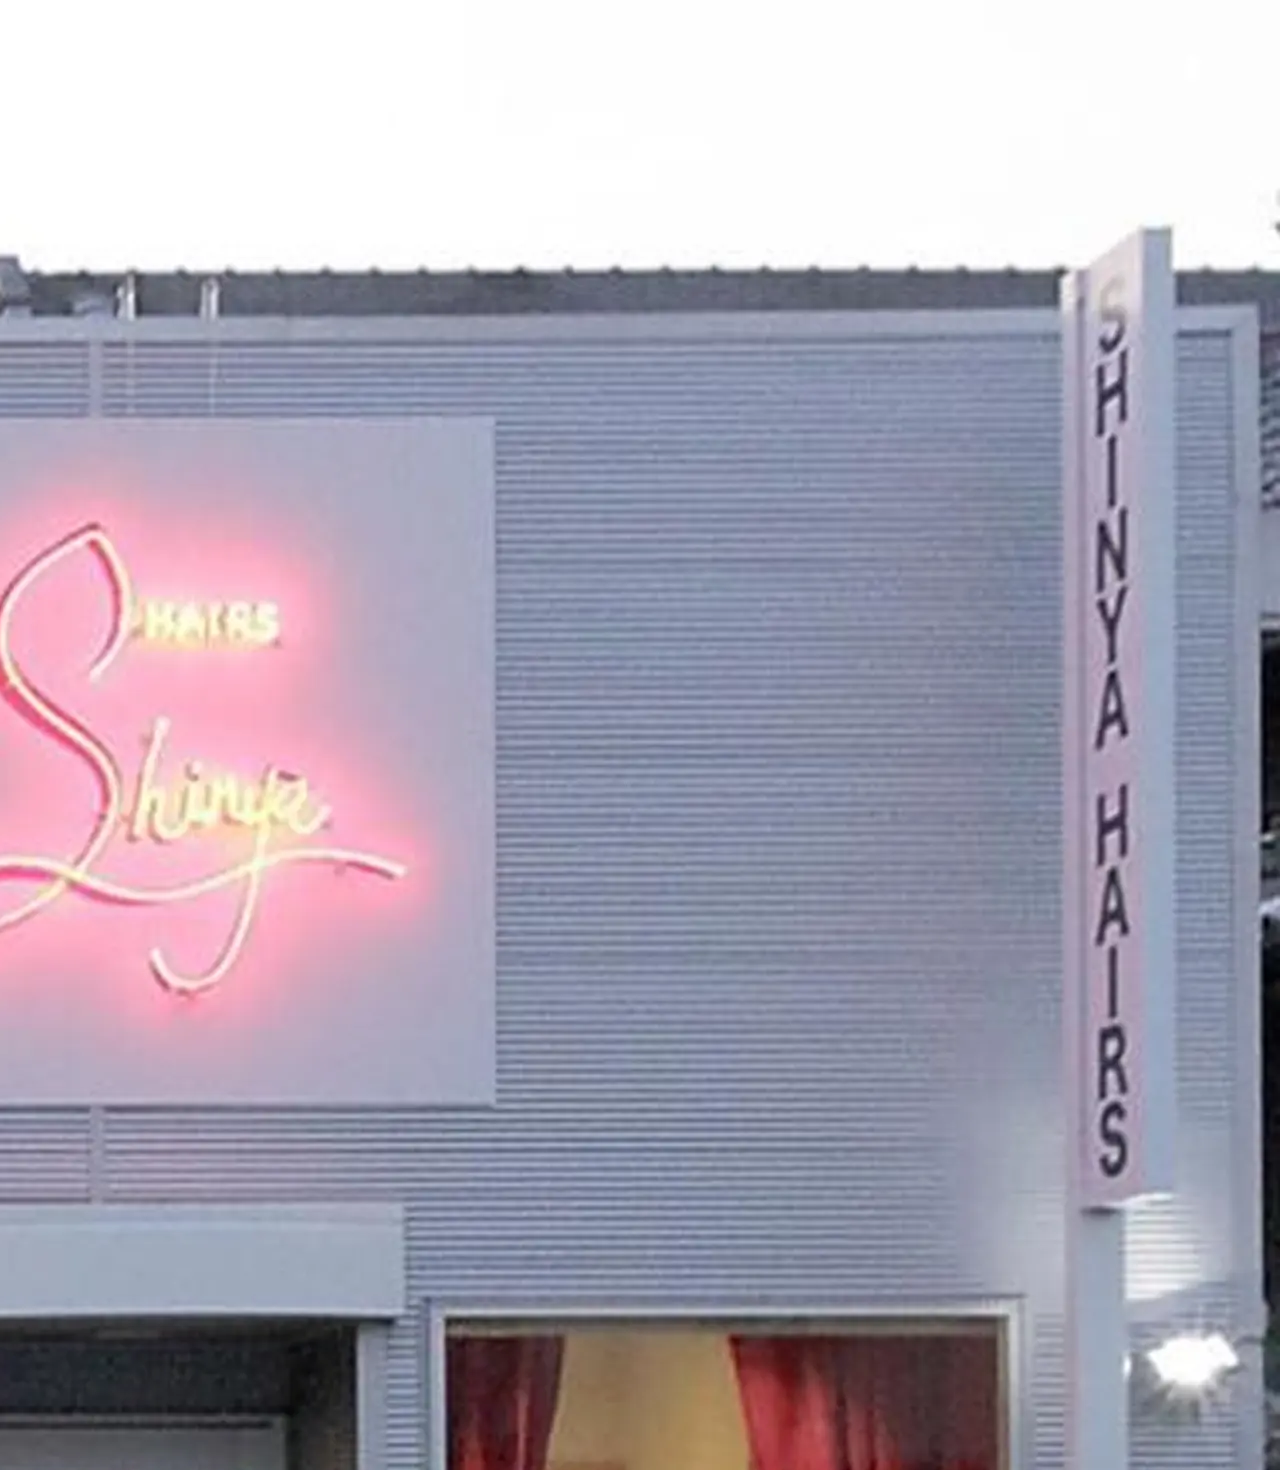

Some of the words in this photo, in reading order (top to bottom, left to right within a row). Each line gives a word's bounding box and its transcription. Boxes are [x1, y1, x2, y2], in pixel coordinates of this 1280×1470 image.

[144, 599, 281, 644] HAIRS
[1095, 279, 1129, 751] SHINYA
[1095, 783, 1129, 1178] HAIRS
